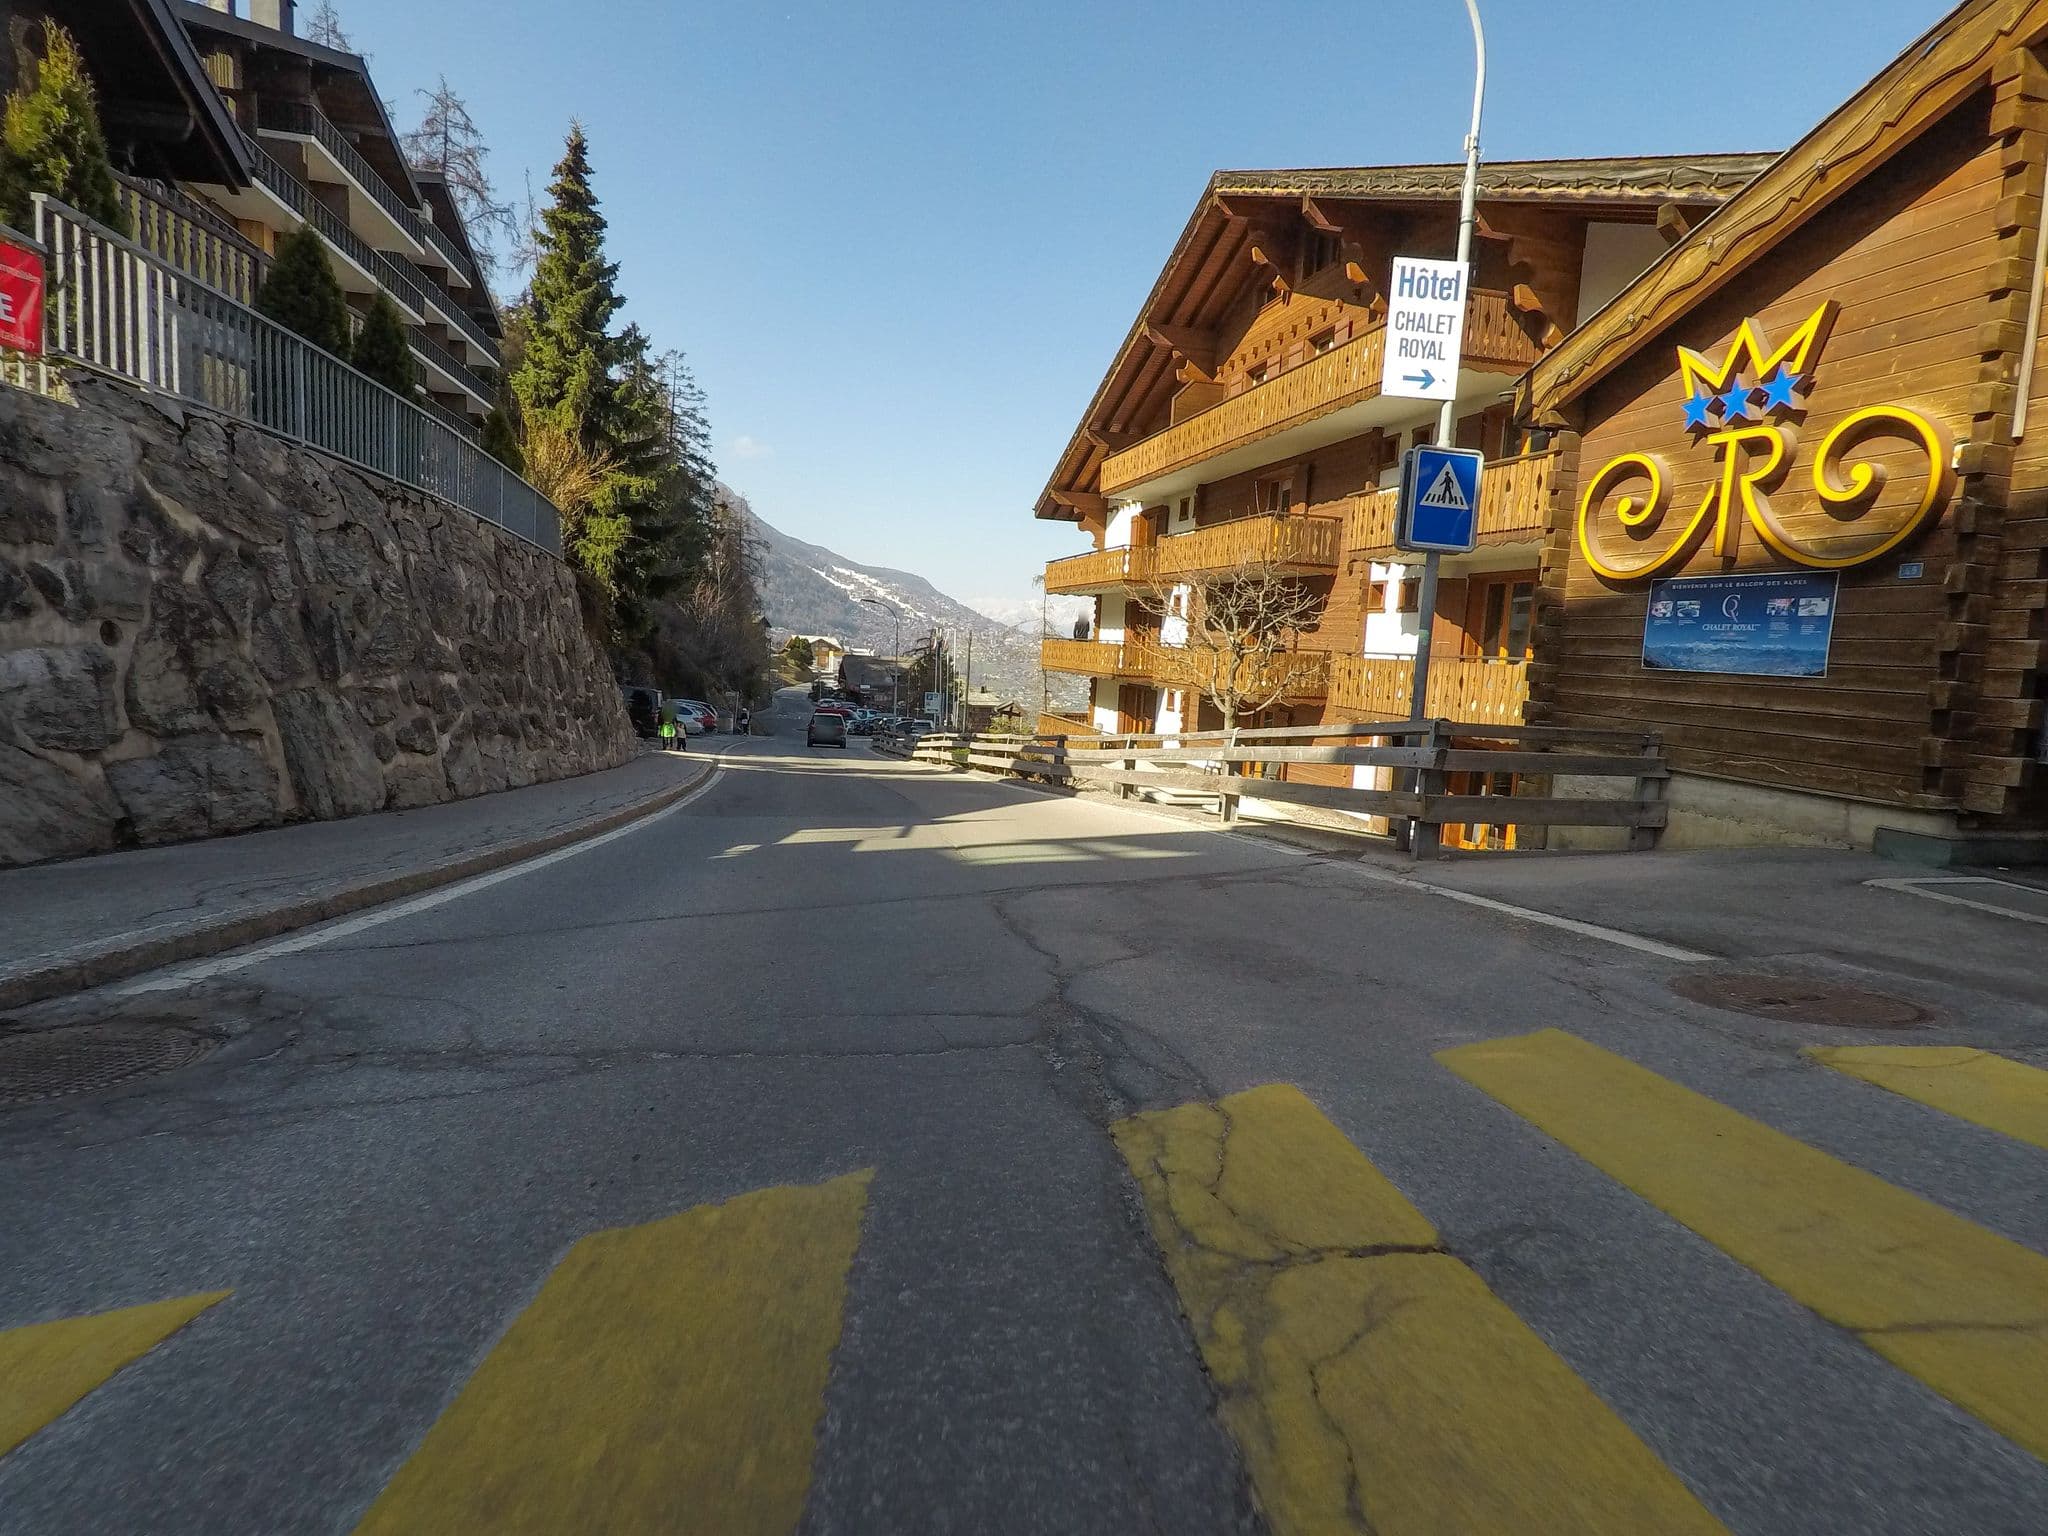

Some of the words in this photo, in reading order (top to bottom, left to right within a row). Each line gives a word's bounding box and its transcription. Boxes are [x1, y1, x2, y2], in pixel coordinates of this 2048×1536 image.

[1398, 265, 1462, 302] Hôtel
[1395, 310, 1456, 335] CHALET
[1398, 337, 1446, 361] ROYAL
[1702, 623, 1732, 631] CHALET
[1732, 623, 1757, 631] ROYAL
